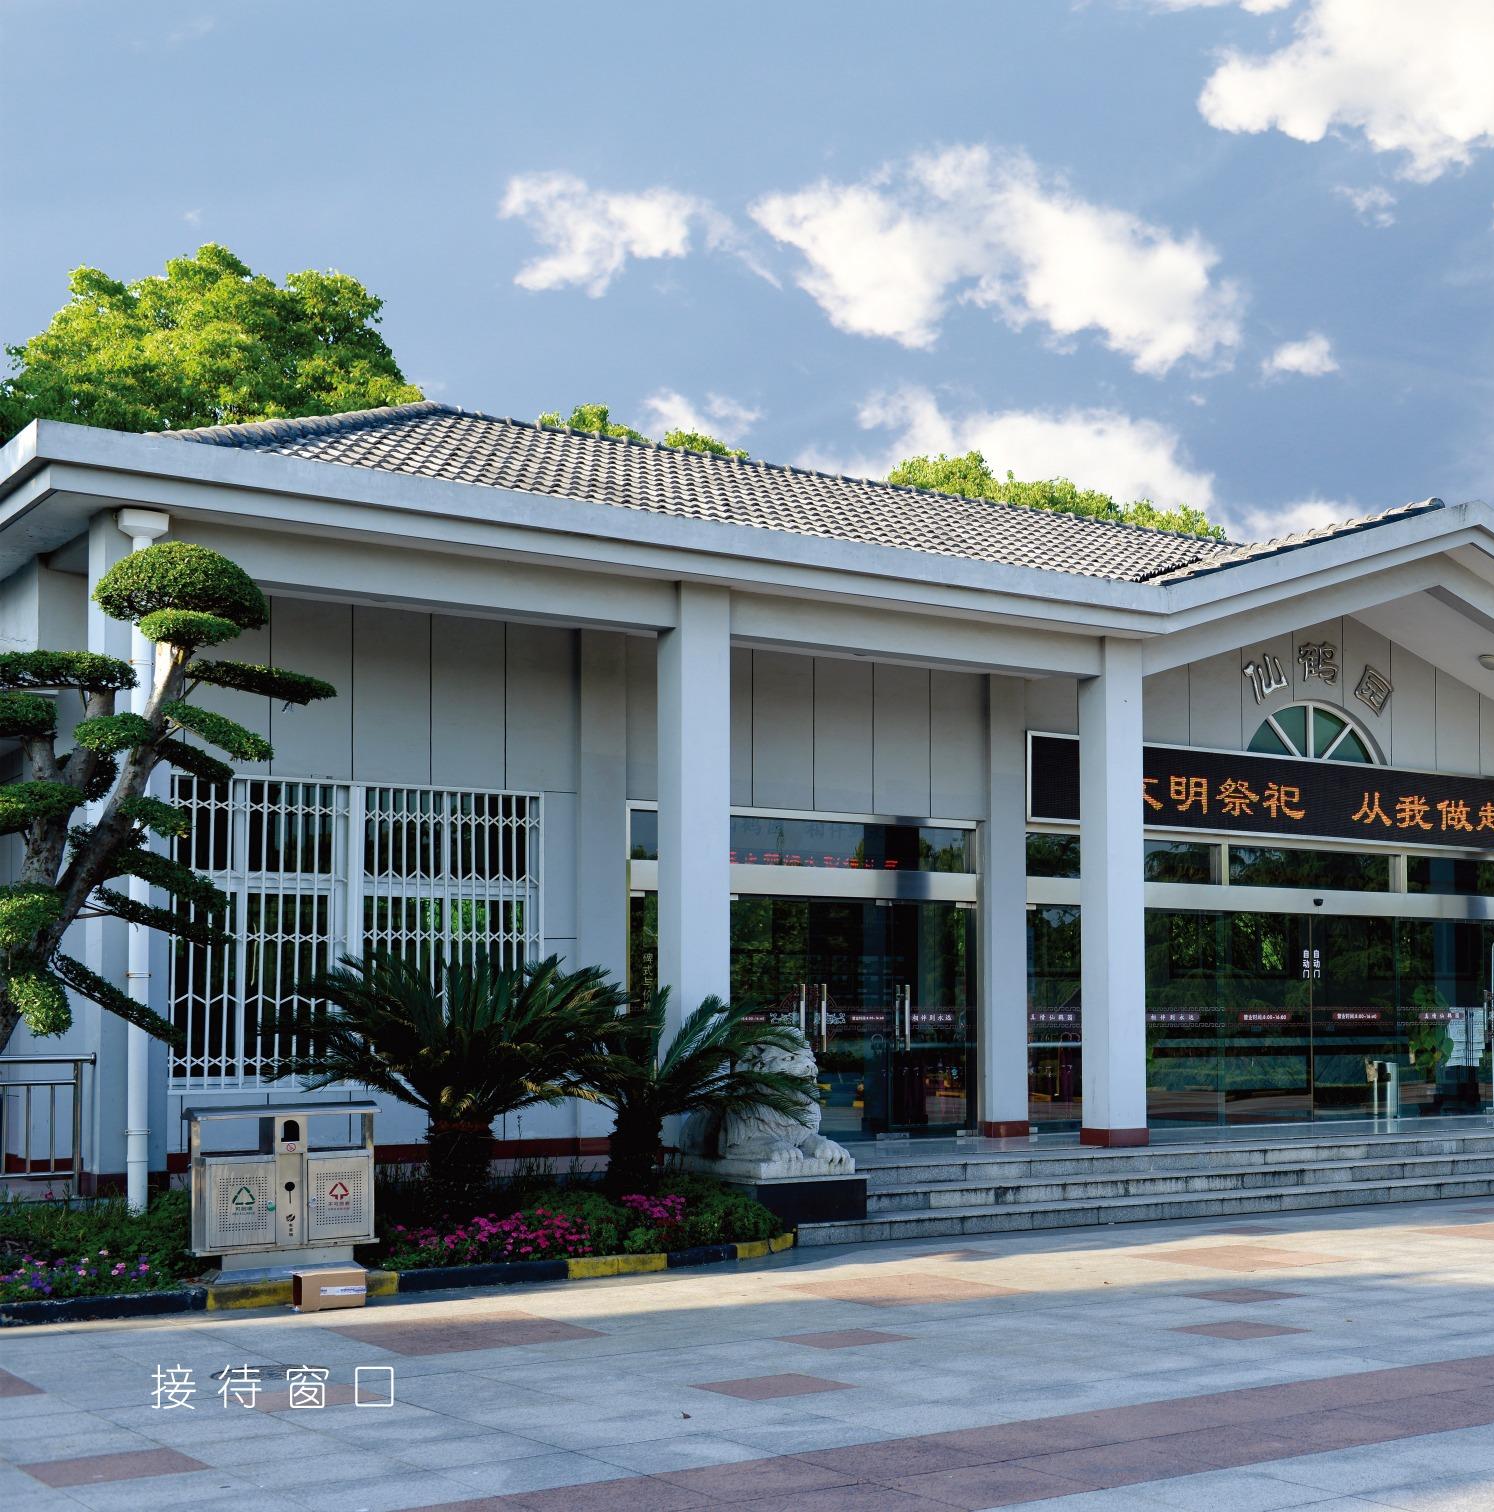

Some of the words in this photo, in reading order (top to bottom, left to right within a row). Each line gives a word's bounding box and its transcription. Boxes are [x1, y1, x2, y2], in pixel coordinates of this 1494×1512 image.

[1243, 641, 1393, 716] 仙鹤园
[1313, 950, 1321, 978] 自动门
